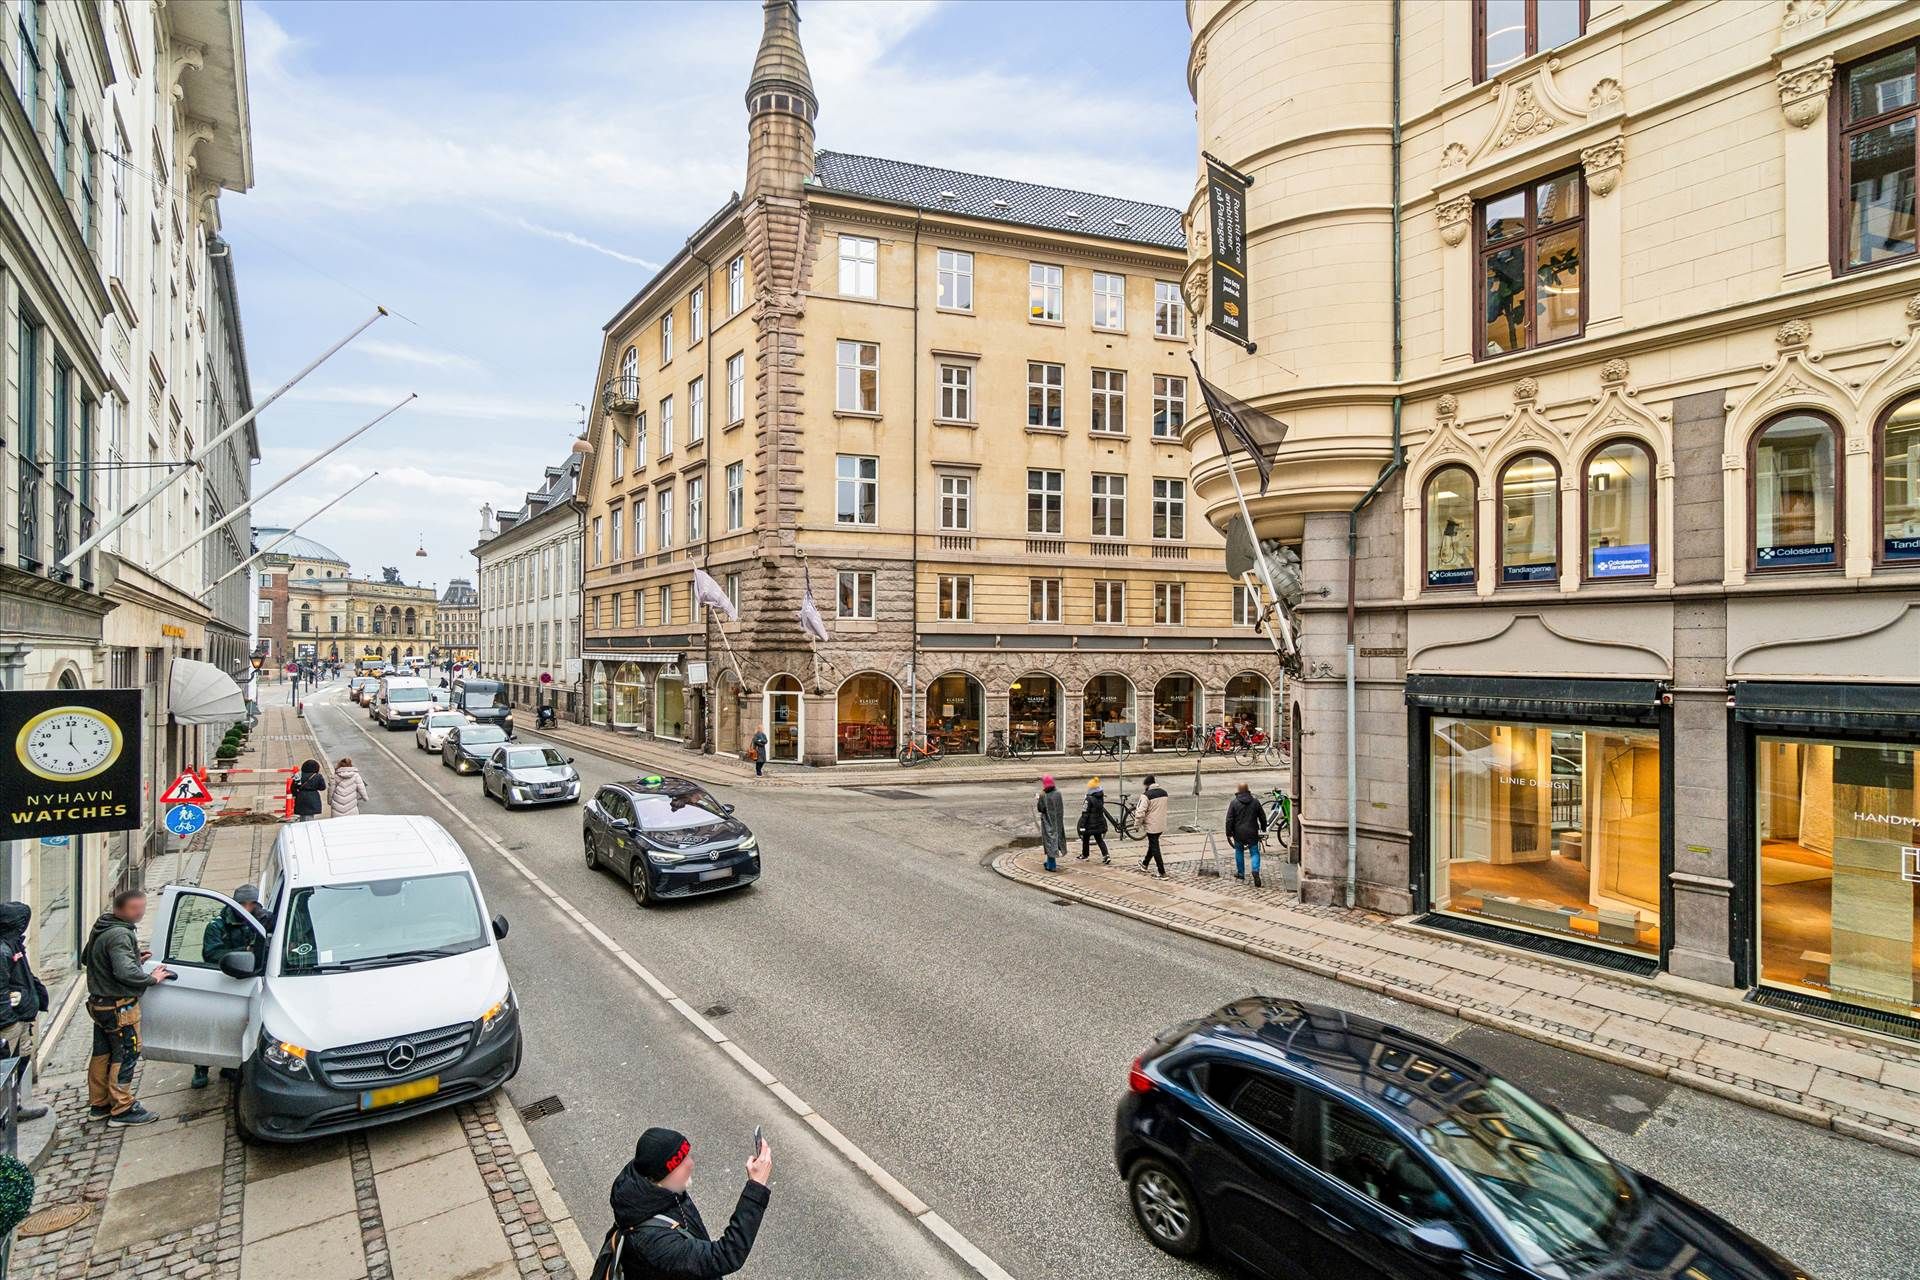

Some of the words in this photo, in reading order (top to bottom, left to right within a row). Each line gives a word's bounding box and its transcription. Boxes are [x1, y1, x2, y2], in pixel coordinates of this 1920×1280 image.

[1233, 198, 1241, 222] Rum
[1225, 193, 1233, 250] ambitioner
[1776, 546, 1832, 557] Colosseum
[1440, 570, 1474, 578] Colosseum
[1507, 565, 1552, 575] Tandlægerne
[1608, 563, 1649, 571] Tandlægerne
[1500, 776, 1526, 786] LINIE
[1529, 779, 1569, 790] DESIGN
[27, 790, 113, 806] NYHAVN
[11, 804, 127, 824] WATCHES
